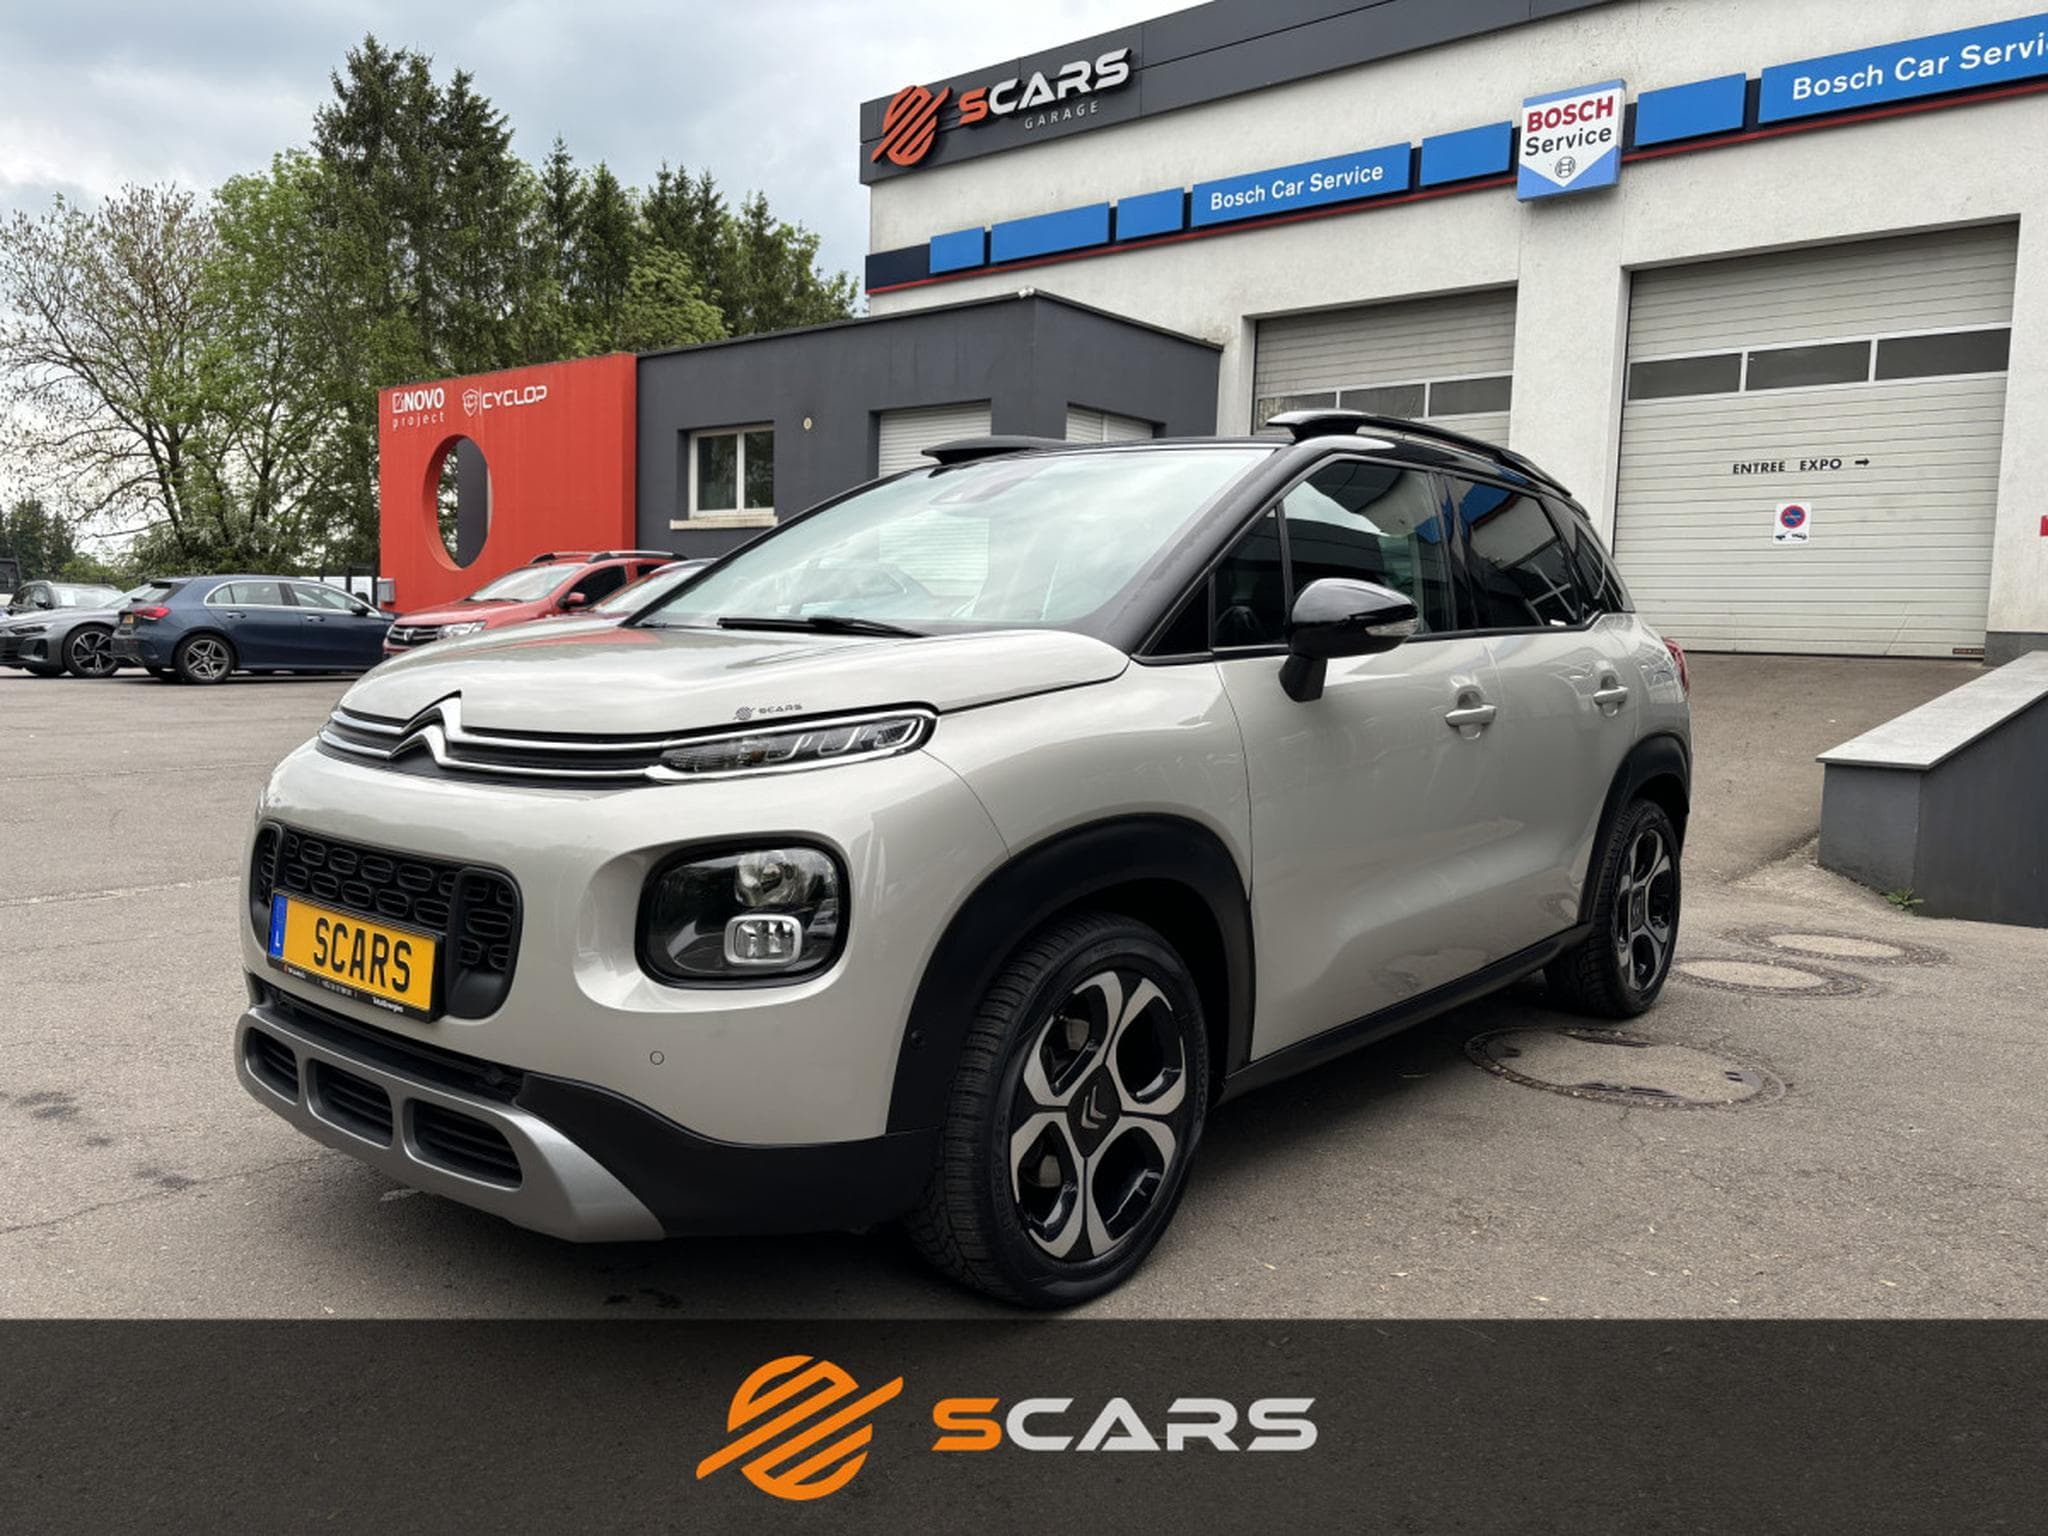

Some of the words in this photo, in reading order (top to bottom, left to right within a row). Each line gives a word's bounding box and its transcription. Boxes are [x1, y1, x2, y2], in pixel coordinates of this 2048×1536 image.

[1792, 64, 1883, 100] Bosch
[1894, 55, 1949, 81] Car
[1959, 32, 2048, 69] Servi
[958, 48, 1129, 126] SCARS
[1025, 101, 1098, 129] GARAGE
[1526, 95, 1614, 133] BOSCH
[1525, 127, 1612, 157] Service
[1210, 184, 1266, 211] Bosch
[1271, 180, 1304, 199] Car
[1309, 165, 1384, 192] Service
[392, 411, 445, 432] project
[1732, 460, 1785, 475] ENTREE
[1799, 458, 1842, 471] EXPO
[758, 703, 803, 714] SCARS
[313, 917, 412, 994] SCARS
